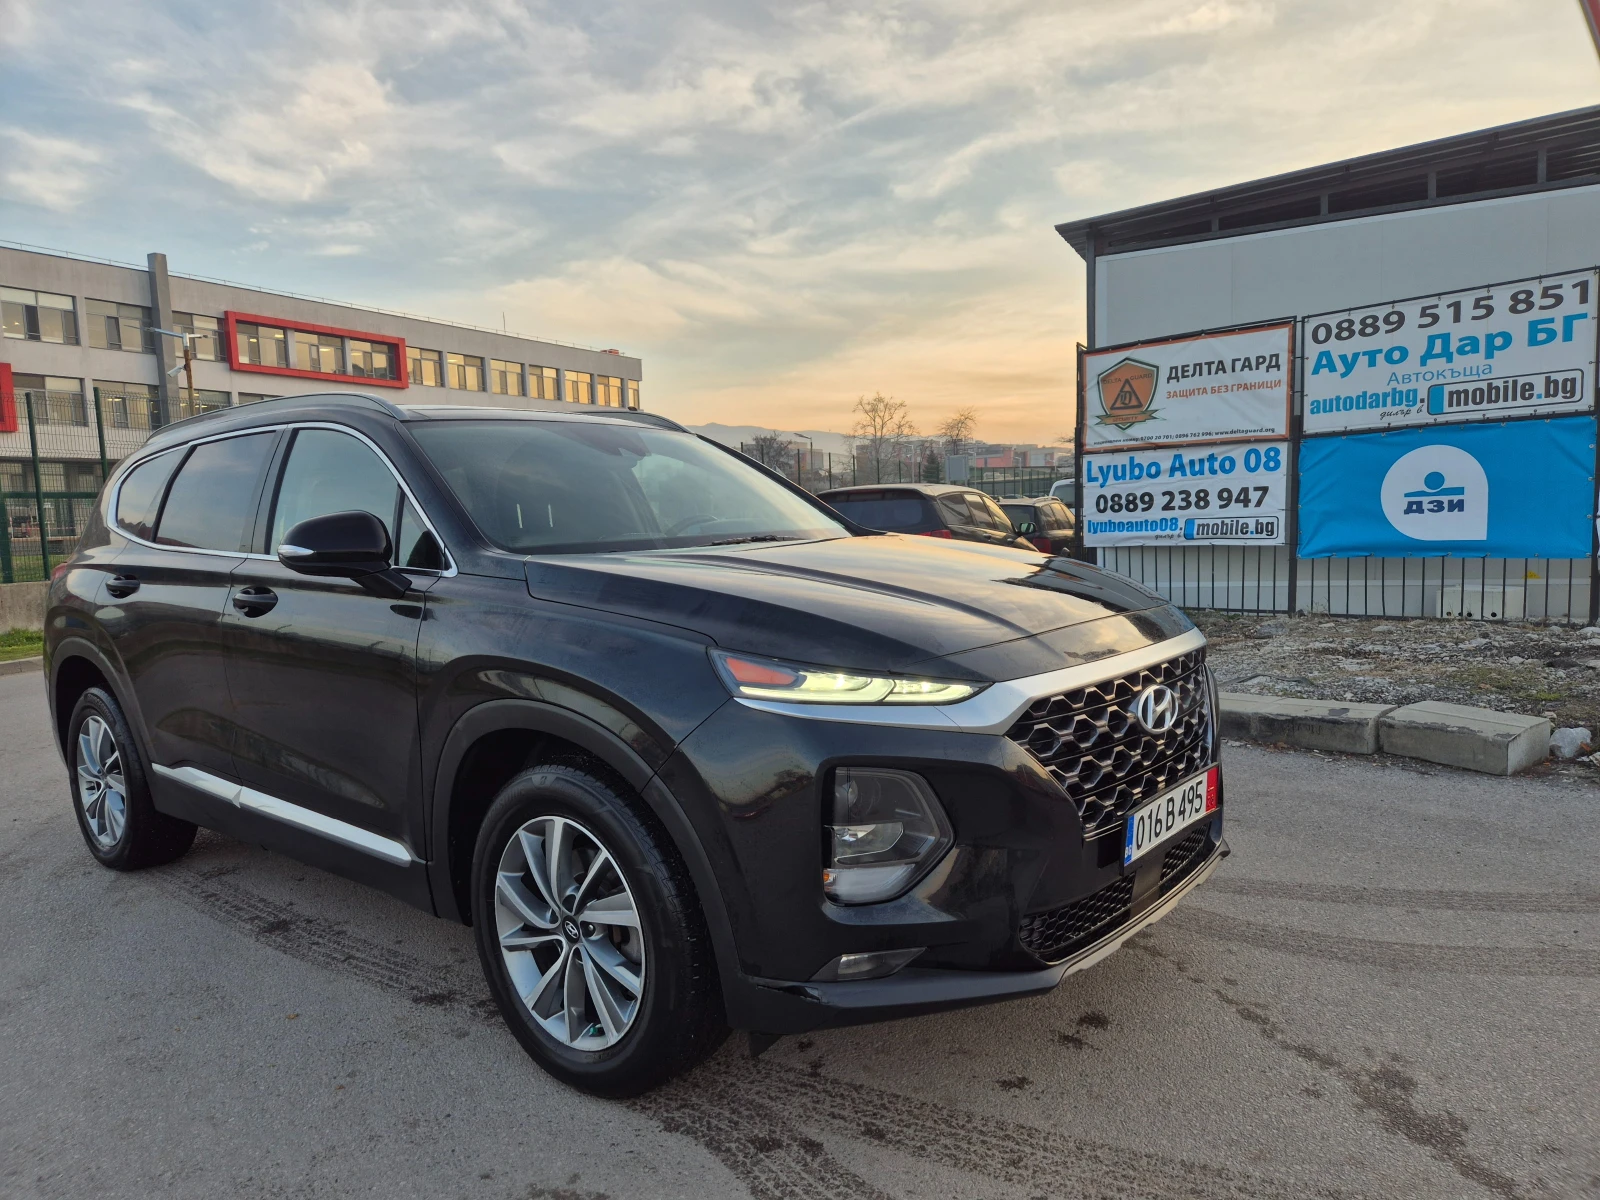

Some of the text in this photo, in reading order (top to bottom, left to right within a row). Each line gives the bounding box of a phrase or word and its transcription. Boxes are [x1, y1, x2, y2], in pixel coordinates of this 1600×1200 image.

[1311, 279, 1590, 345] 0889 515 851
[1311, 312, 1588, 379] Ауто Дар БГ
[1166, 353, 1281, 384] ДЕЛТА ГАРД
[1386, 364, 1493, 387] Автокъща
[1166, 379, 1282, 400] ЗАЩИТА БЕЗ ГРАНИЦИ
[1447, 375, 1577, 408] mobile.bg
[1214, 427, 1275, 436] www.deltaguard.org
[1086, 446, 1282, 488] Lyubo Auto 08
[1095, 485, 1270, 514] 0889 238 947
[1196, 518, 1276, 537] mobile.bg
